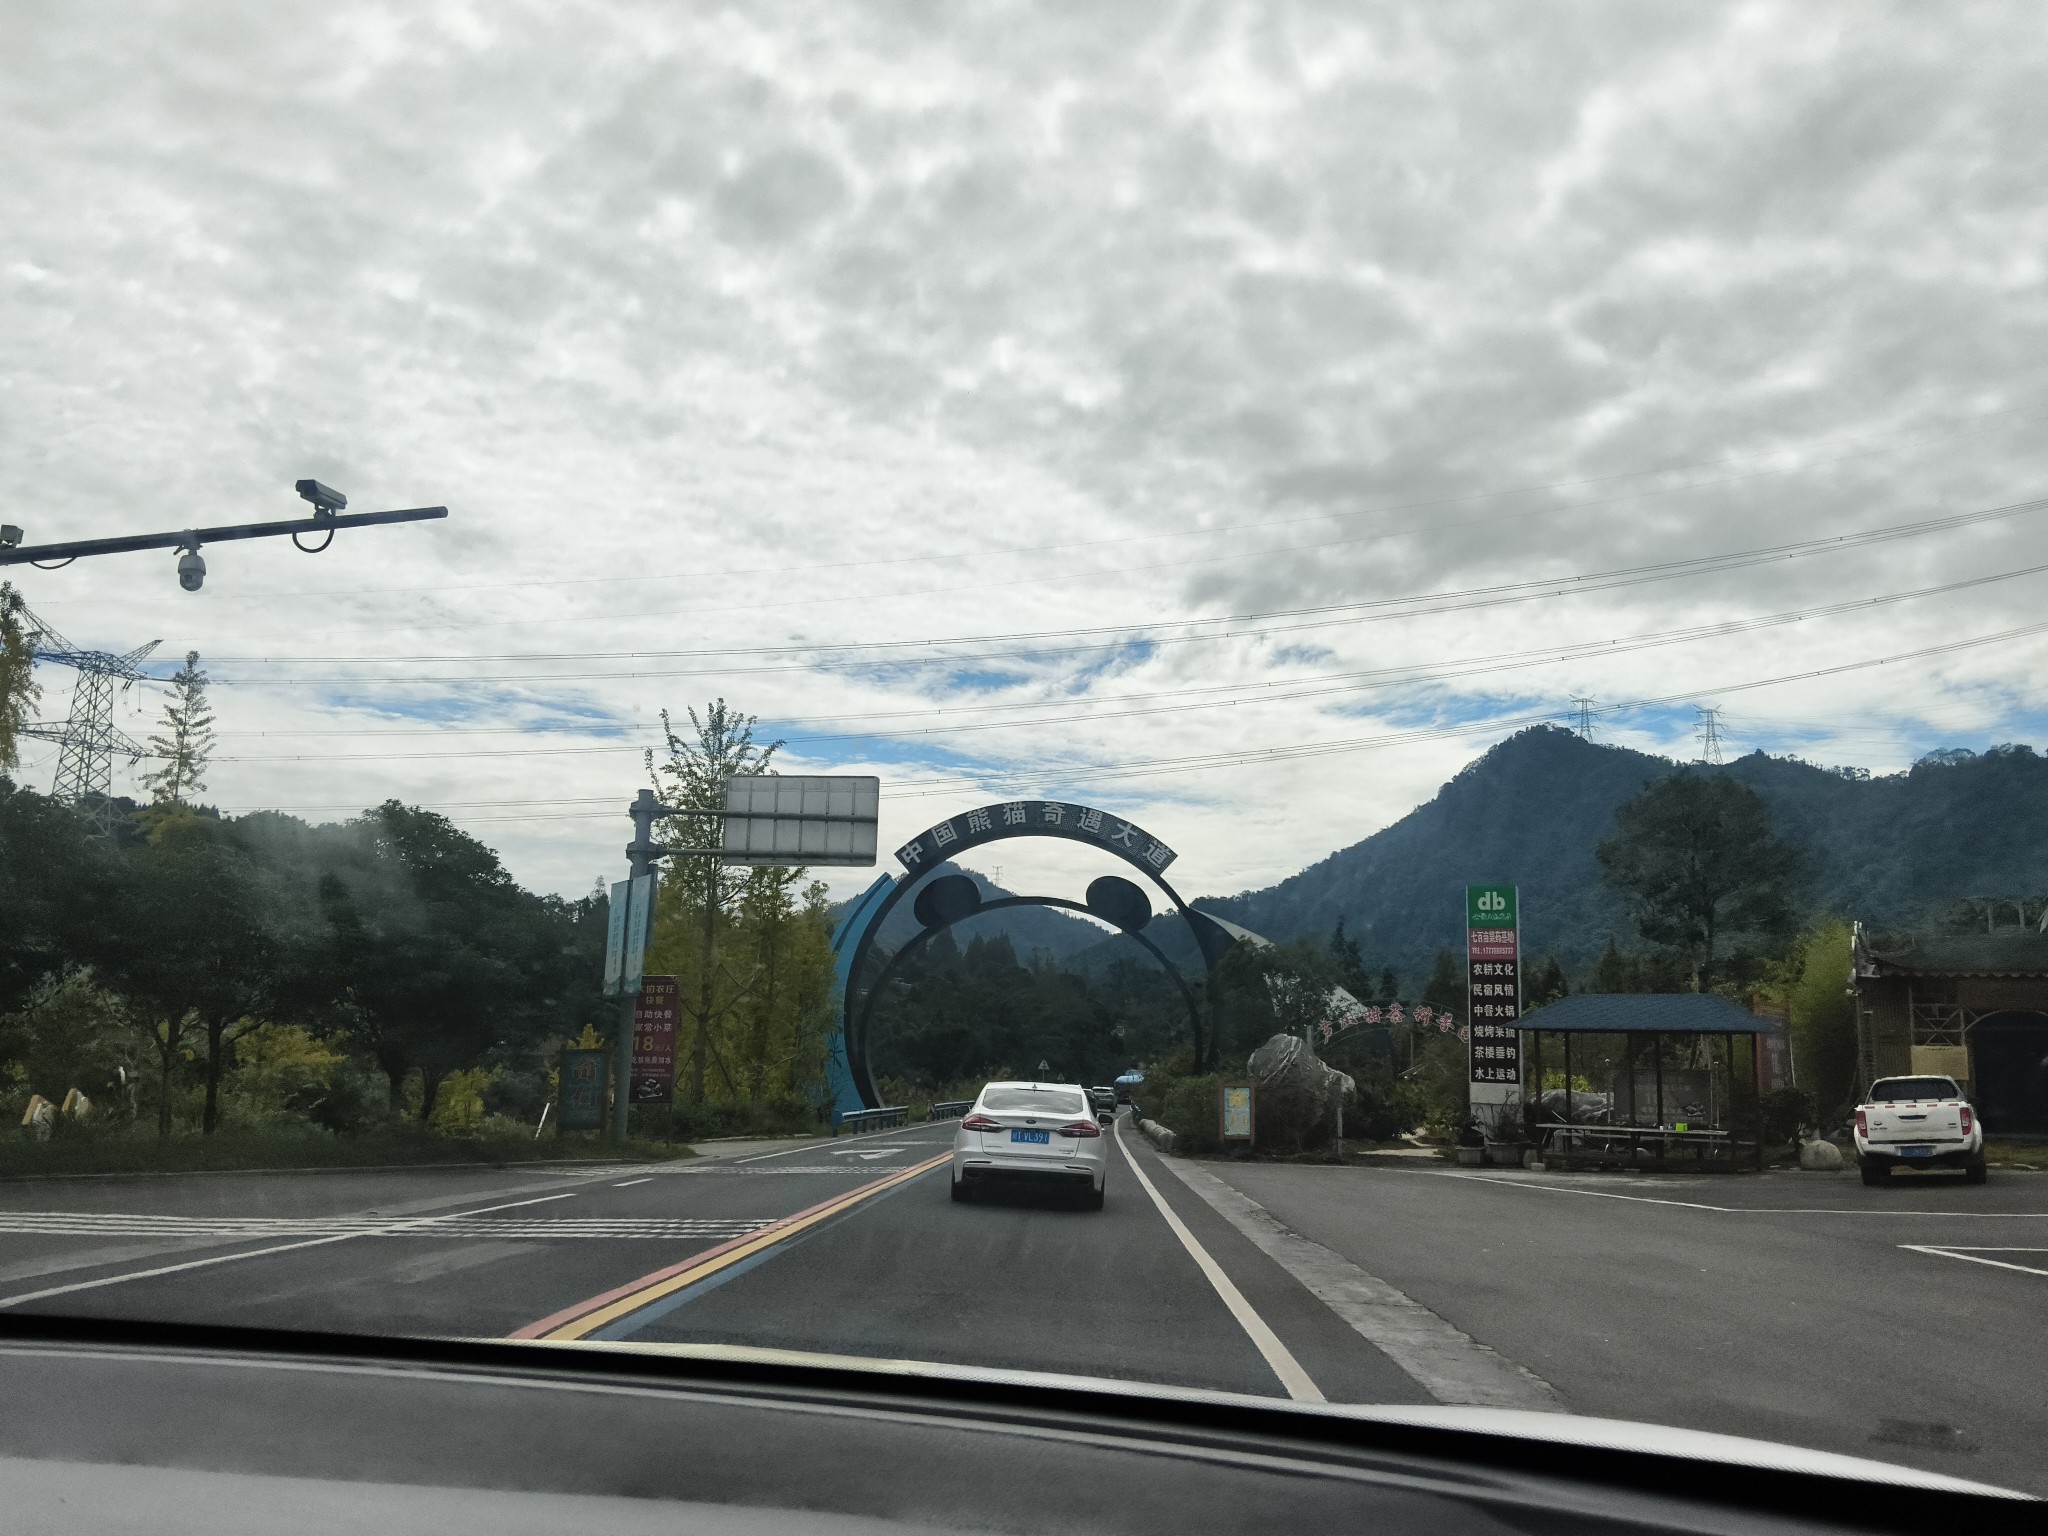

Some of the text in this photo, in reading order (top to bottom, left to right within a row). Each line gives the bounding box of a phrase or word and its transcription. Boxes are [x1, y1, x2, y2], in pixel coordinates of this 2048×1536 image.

[901, 801, 1170, 867] 中国熊猫奇遇大道
[1473, 963, 1514, 976] 农耕文化
[1473, 984, 1514, 996] 民宿风情
[1474, 1004, 1515, 1017] 中餐火锅
[1474, 1046, 1516, 1059] 茶楼垂钓
[1475, 1067, 1516, 1080] 水上运动
